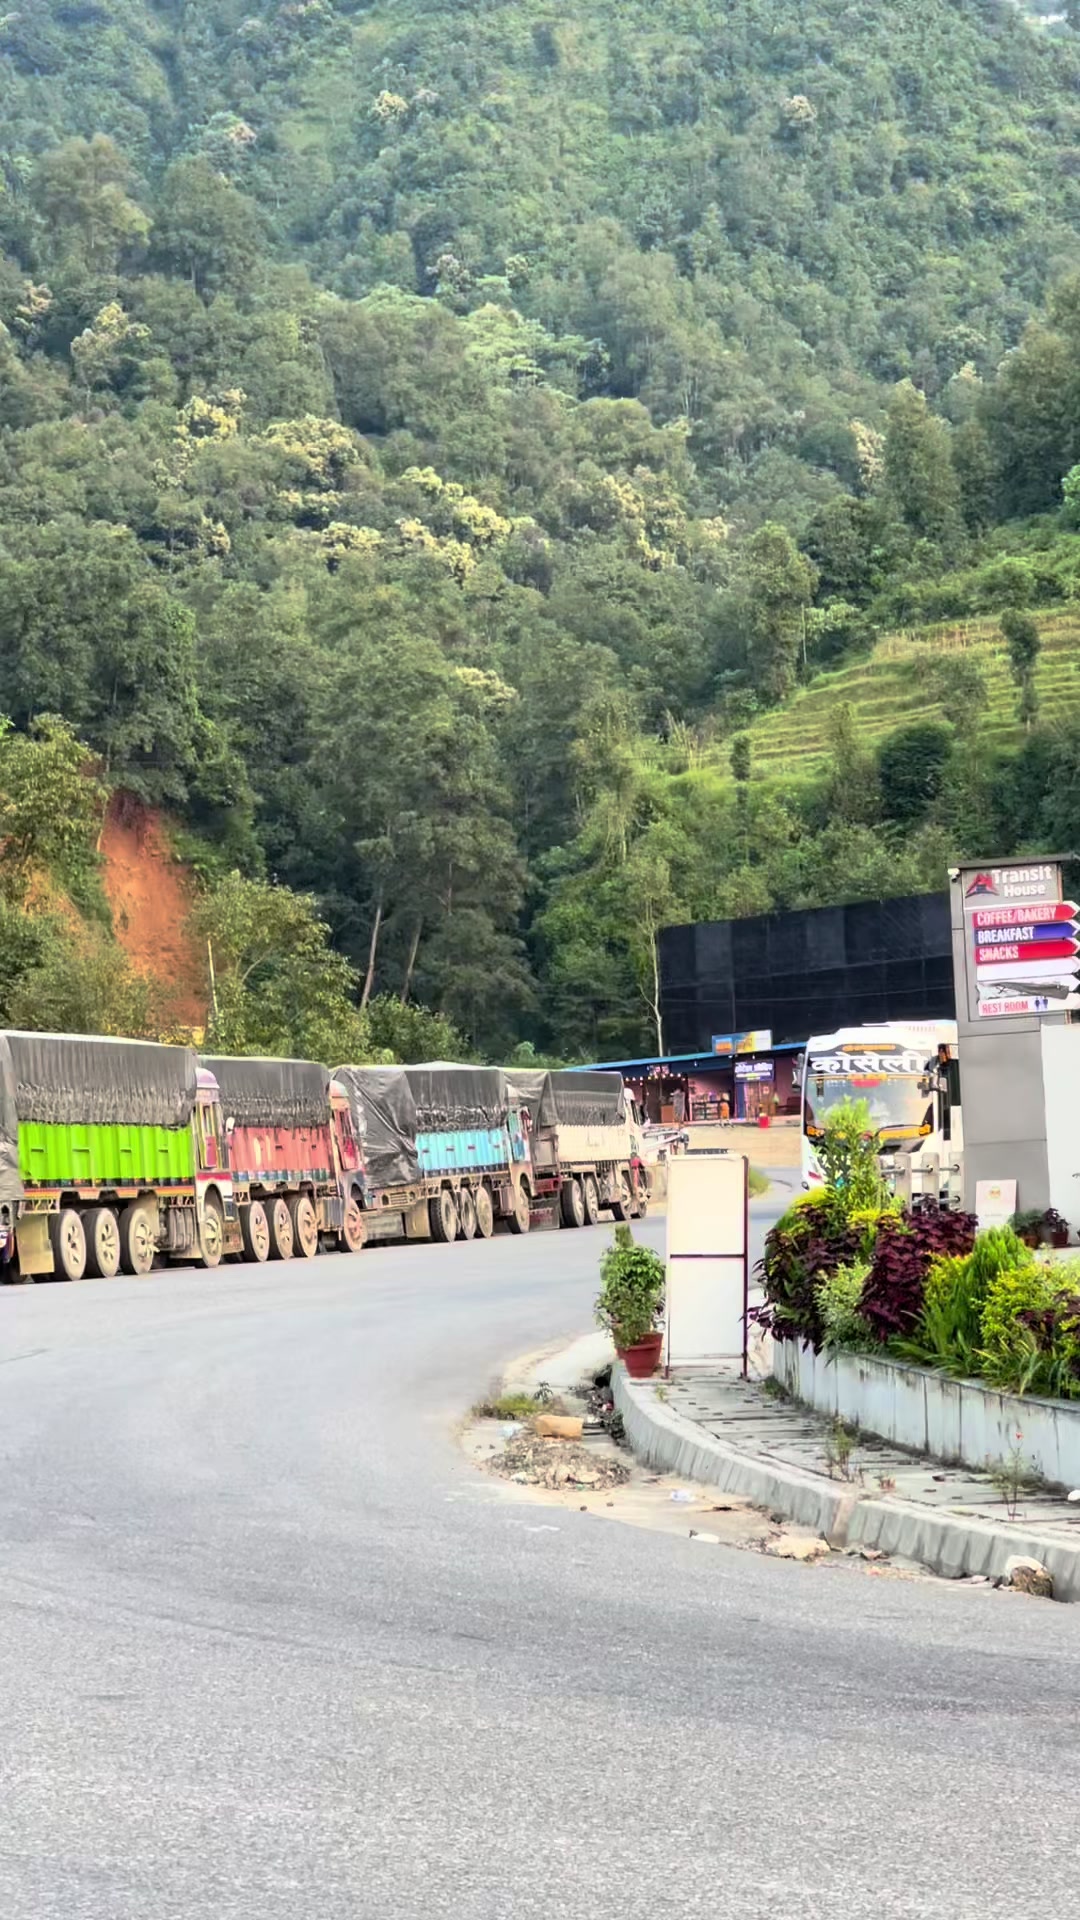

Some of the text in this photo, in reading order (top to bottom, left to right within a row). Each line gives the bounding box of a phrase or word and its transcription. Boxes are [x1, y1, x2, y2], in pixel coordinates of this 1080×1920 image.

[992, 866, 1052, 884] Transit
[1004, 884, 1046, 897] House
[977, 907, 1056, 925] COFFEE/BAKERY
[978, 926, 1034, 944] BREAKFAST
[979, 946, 1019, 961] SNACKS
[982, 1001, 1029, 1014] REST ROOM
[810, 1051, 927, 1073] कोसेली
